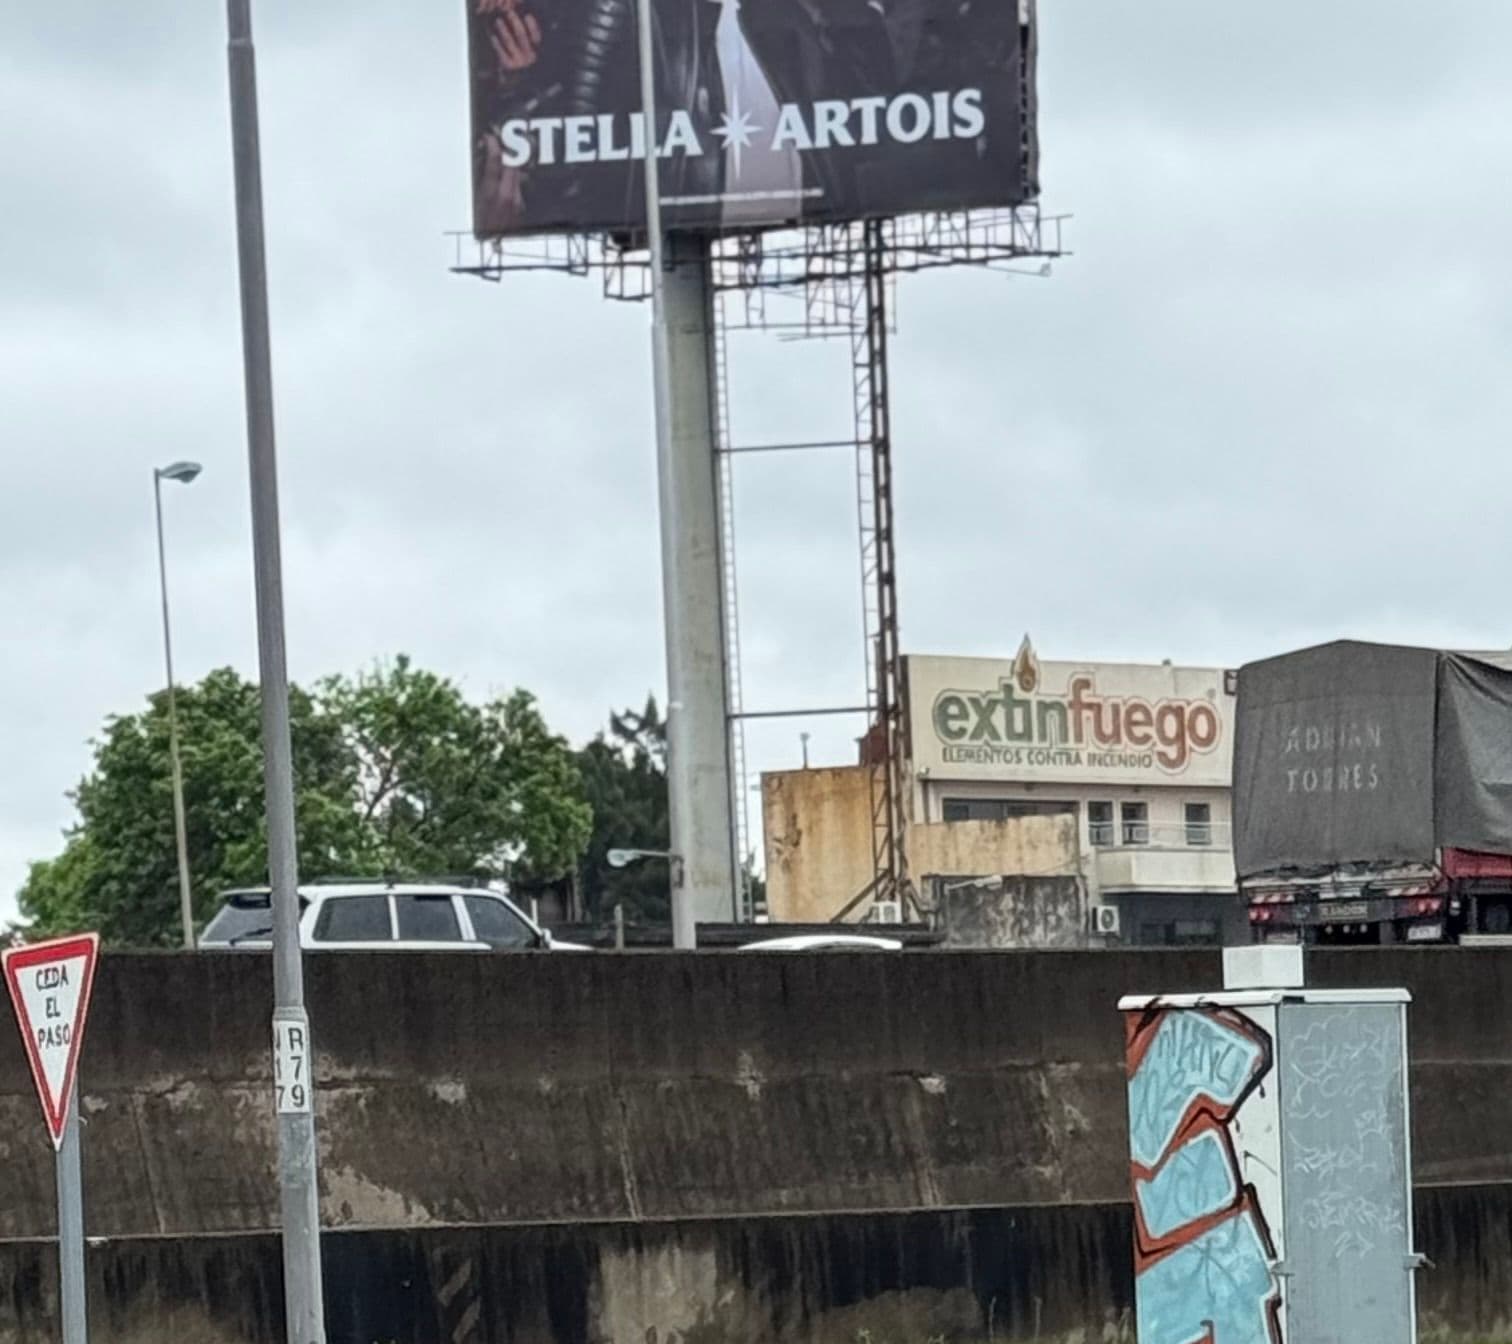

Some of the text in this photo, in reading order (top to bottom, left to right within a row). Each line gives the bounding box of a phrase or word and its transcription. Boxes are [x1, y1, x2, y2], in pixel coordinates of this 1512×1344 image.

[501, 88, 985, 167] STELLA ARTOIS
[936, 677, 1217, 770] extinfuego
[942, 747, 1153, 768] ELEMENTOS CONTRA INCENDIO
[36, 964, 69, 991] CEDA
[46, 997, 61, 1018] EL
[38, 1023, 70, 1049] PASO
